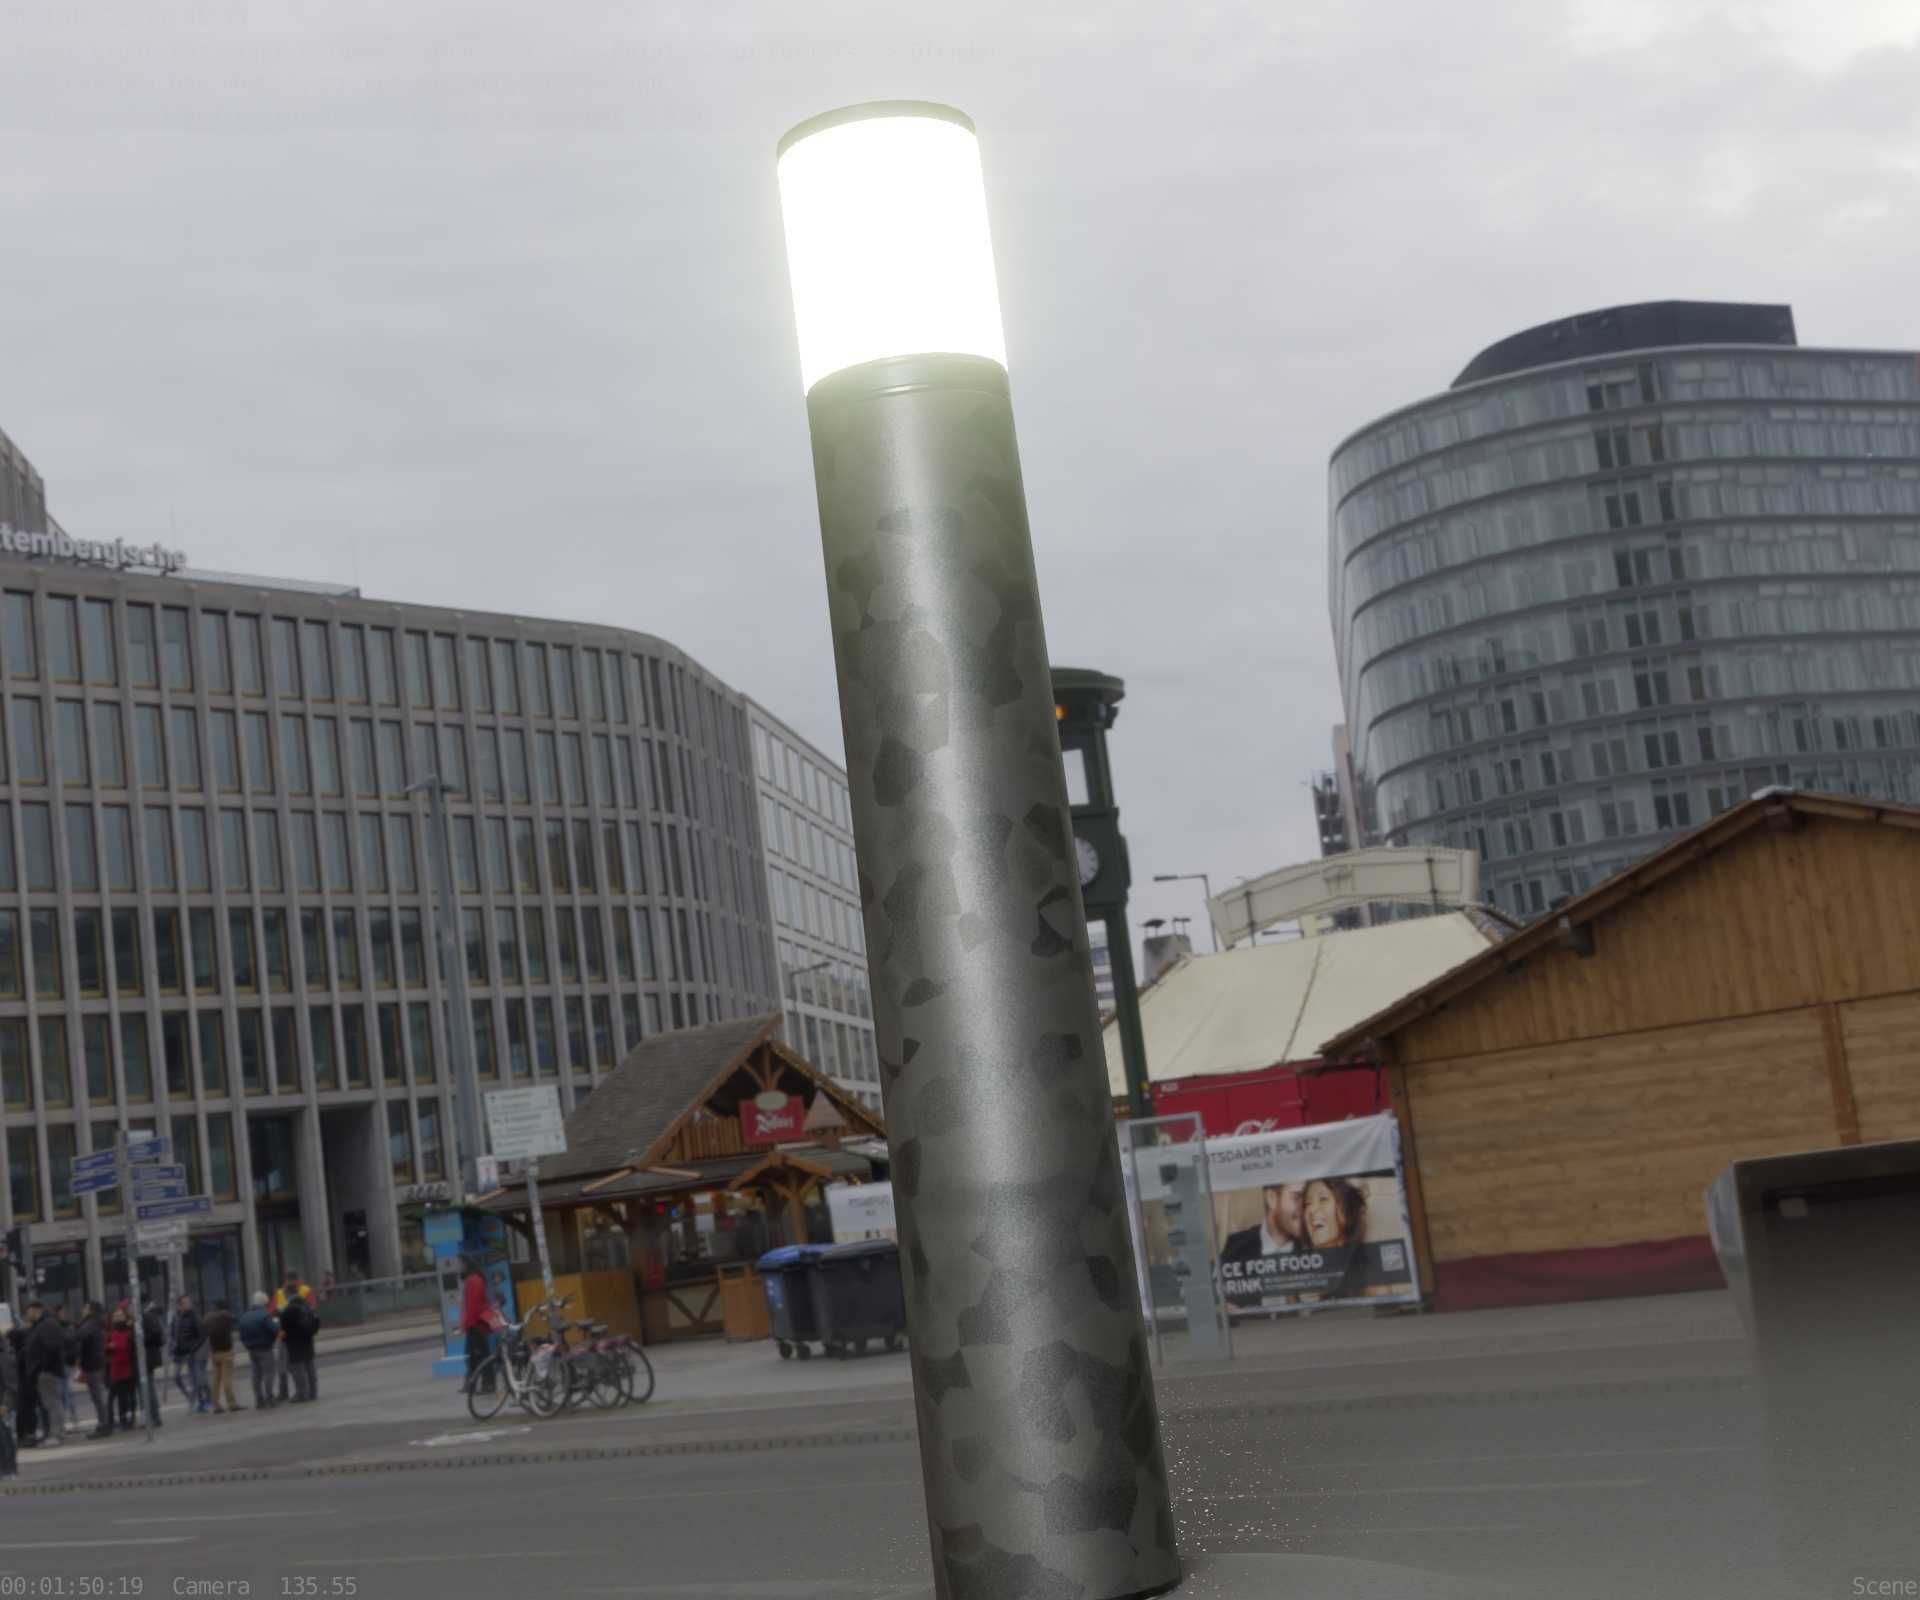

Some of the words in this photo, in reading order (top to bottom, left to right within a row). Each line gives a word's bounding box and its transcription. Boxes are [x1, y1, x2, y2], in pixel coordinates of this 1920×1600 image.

[0, 522, 187, 568] tembergische
[1192, 1144, 1273, 1166] PTSDAMER
[1275, 1137, 1321, 1157] PLATZ
[1246, 1257, 1277, 1276] FOR
[1280, 1253, 1324, 1272] FOOD
